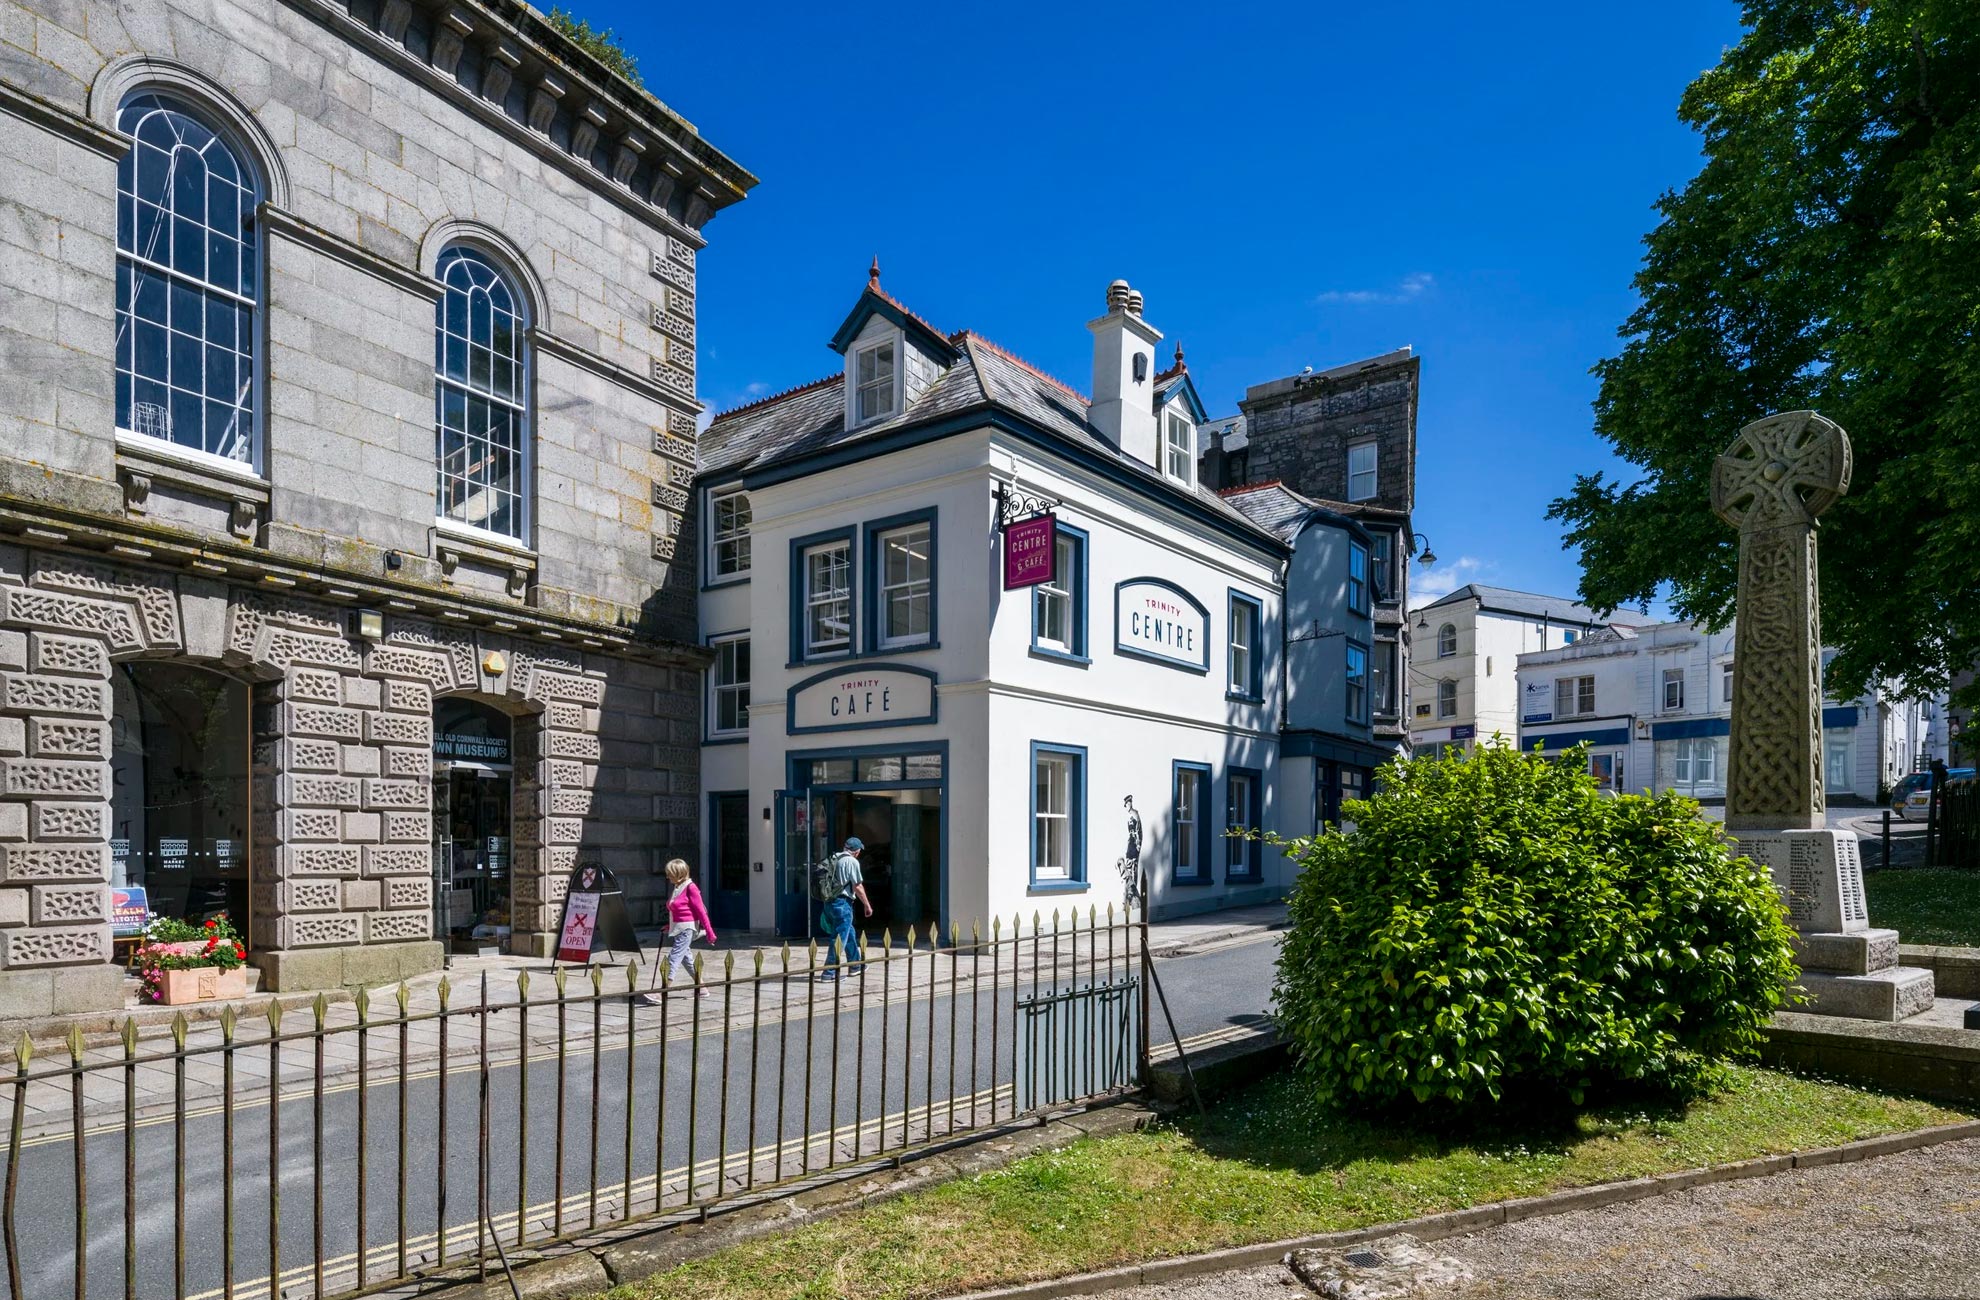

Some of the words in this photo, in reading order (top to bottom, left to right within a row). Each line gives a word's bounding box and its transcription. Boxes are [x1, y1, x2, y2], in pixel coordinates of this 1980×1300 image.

[1016, 528, 1042, 539] TRINITY
[1012, 534, 1047, 553] CENTRE
[1024, 554, 1044, 568] CAFÉ
[1145, 599, 1181, 617] TRINITY
[1132, 611, 1193, 652] CENTRE
[841, 679, 879, 691] TRINITY
[831, 686, 890, 716] CAFÉ
[444, 733, 456, 742] OLD
[456, 734, 485, 745] CORNWALL
[485, 736, 507, 747] SOCIETY
[455, 743, 499, 758] MUSEUM
[565, 936, 587, 946] OPEN
